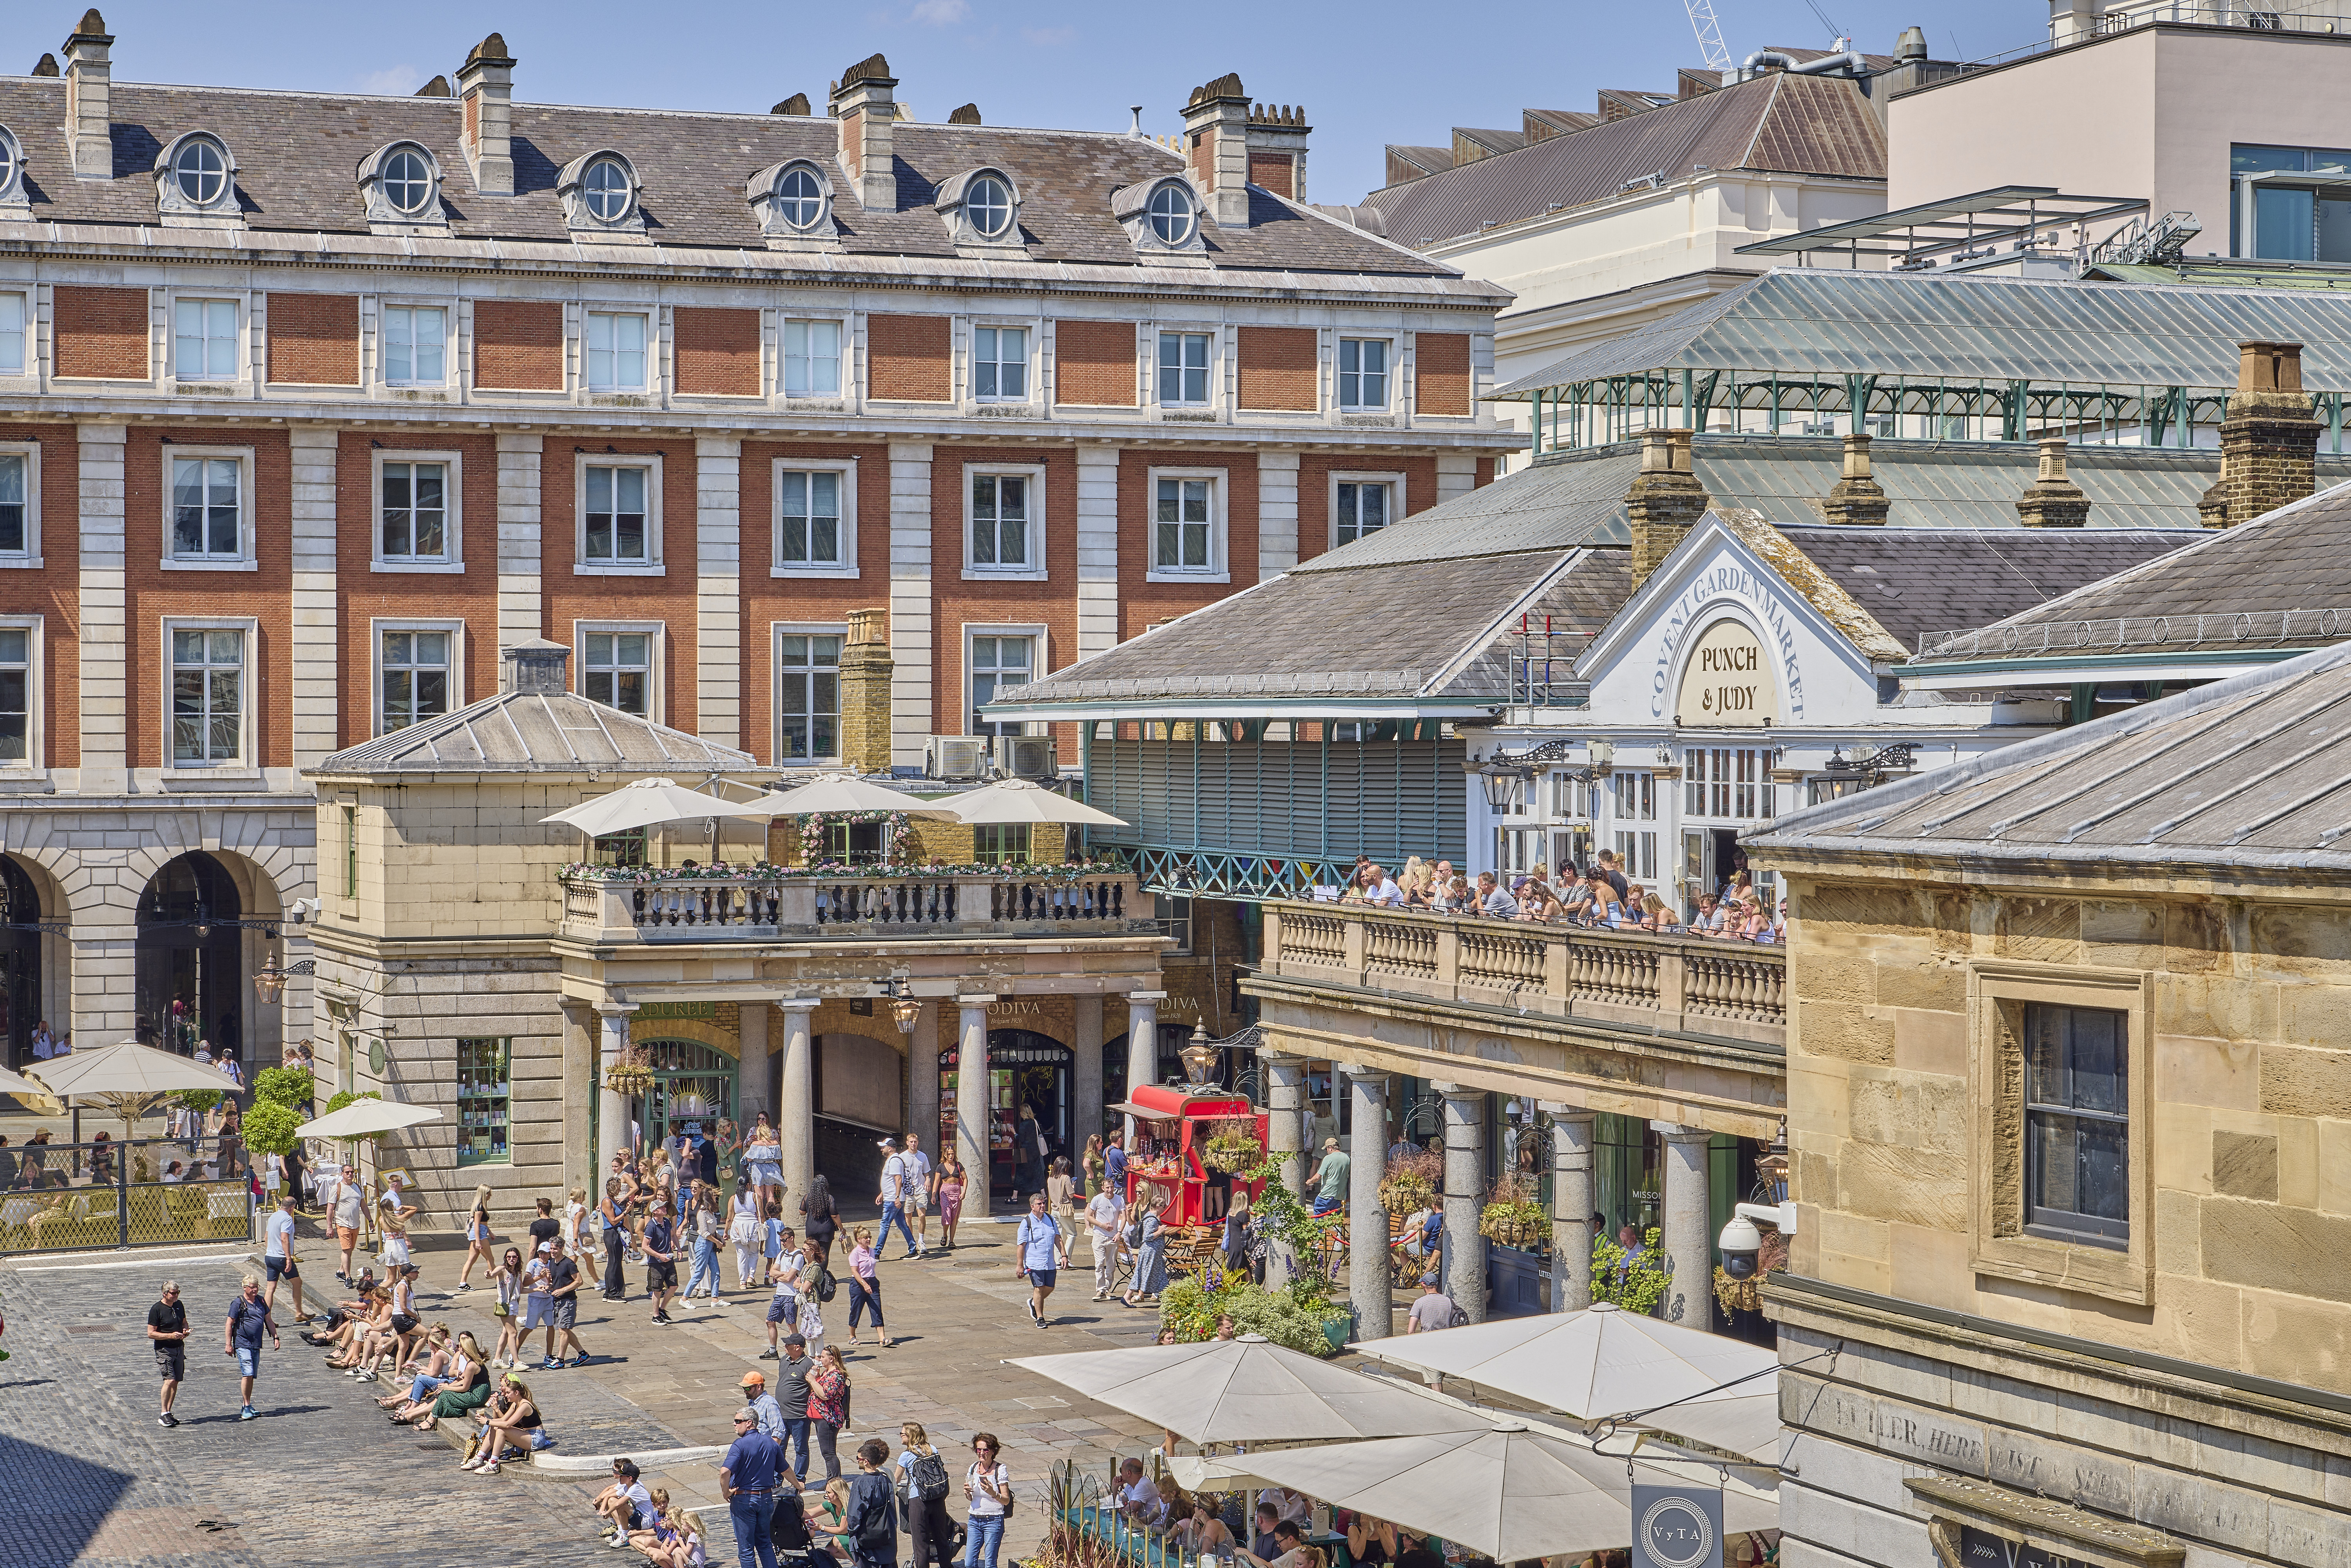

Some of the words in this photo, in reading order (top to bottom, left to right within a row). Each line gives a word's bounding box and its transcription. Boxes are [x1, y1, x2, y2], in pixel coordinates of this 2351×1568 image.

[1652, 593, 1691, 717] COVENT
[1694, 567, 1764, 605] GARDEN
[1761, 591, 1804, 720] MARKET
[1702, 646, 1757, 672] PUNCH
[1703, 688, 1712, 711] &
[1715, 686, 1757, 716] JUDY
[630, 1001, 708, 1016] ADUREE
[987, 1002, 1040, 1015] ODIVA
[1156, 997, 1198, 1010] DIVA
[1633, 1190, 1661, 1199] MISSO
[1539, 1269, 1552, 1279] LITTER
[1927, 1428, 2042, 1479] HERBALIST
[1653, 1526, 1701, 1541] VyTA
